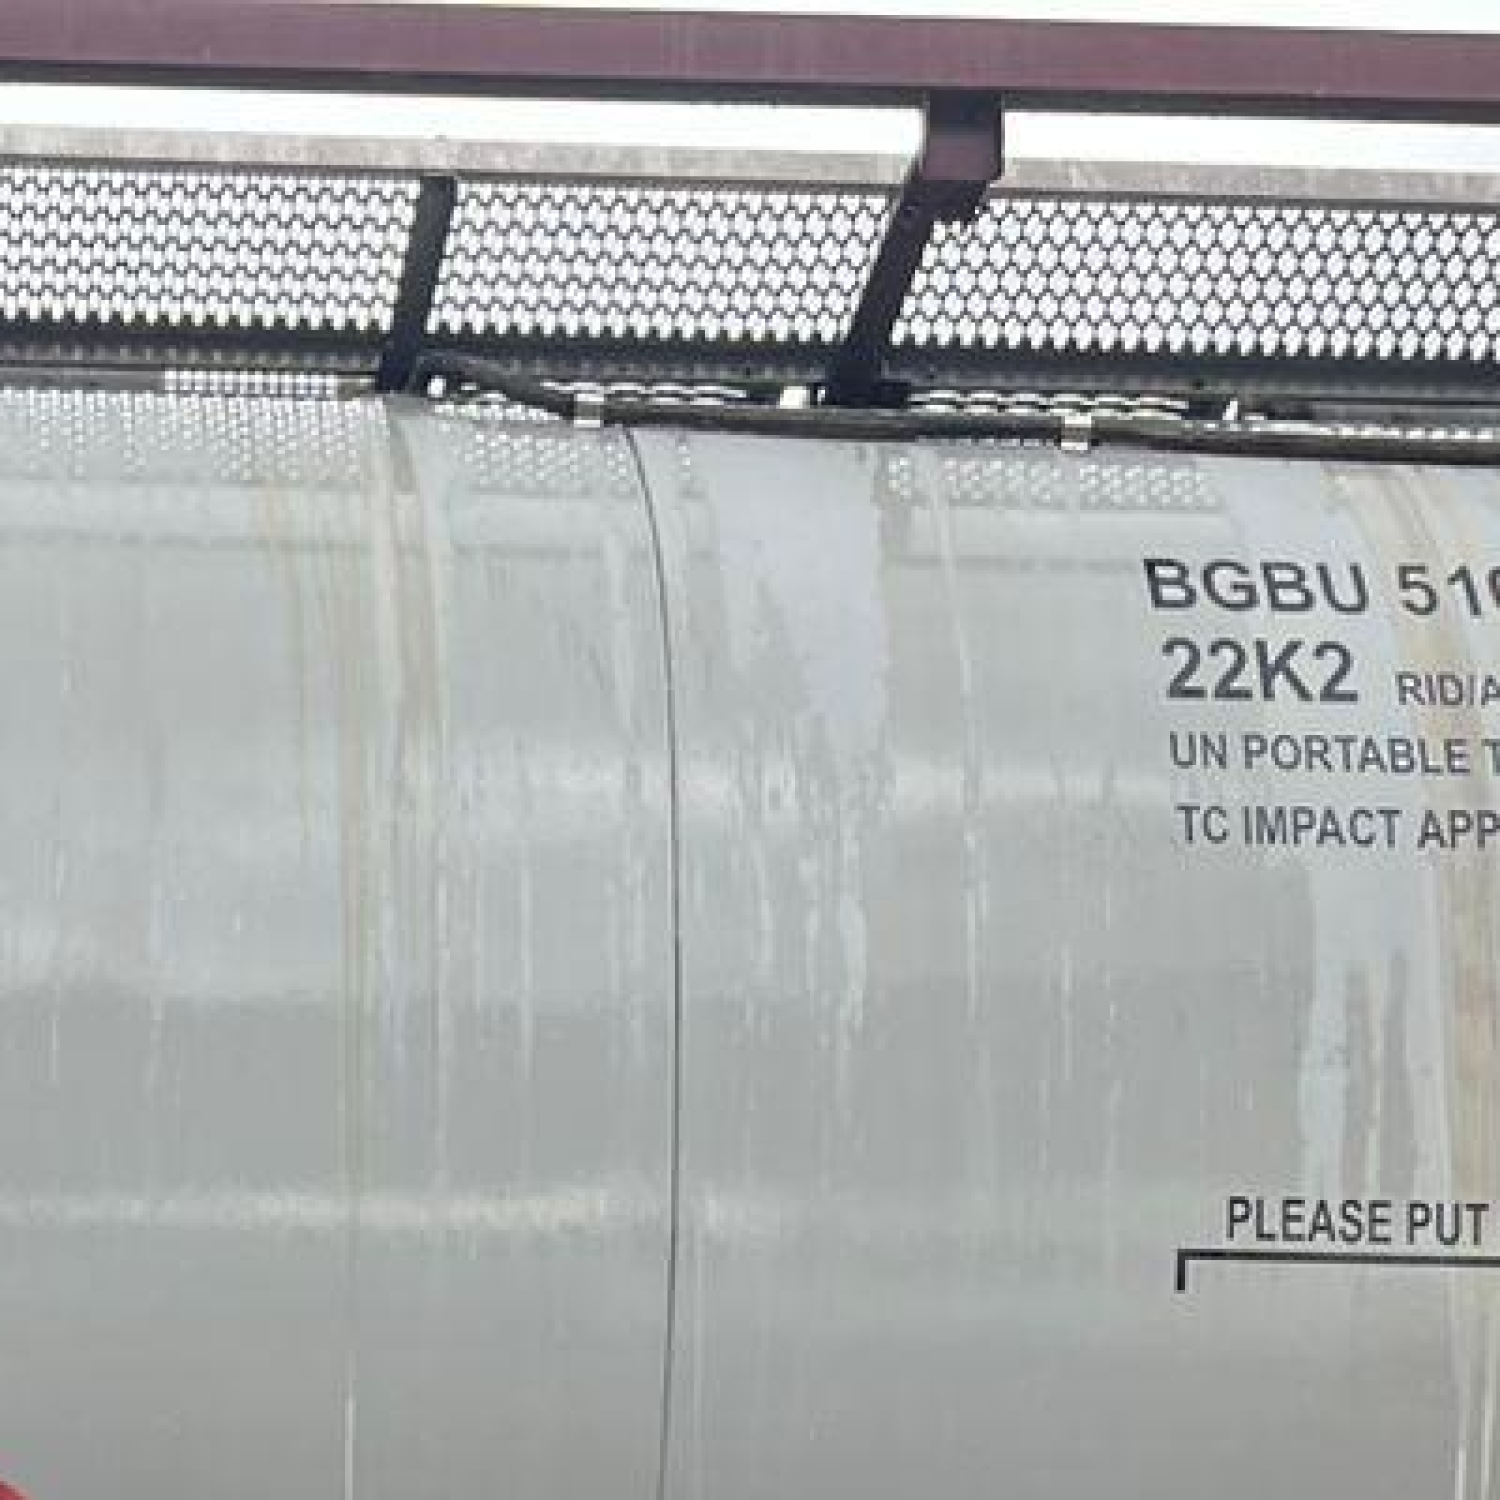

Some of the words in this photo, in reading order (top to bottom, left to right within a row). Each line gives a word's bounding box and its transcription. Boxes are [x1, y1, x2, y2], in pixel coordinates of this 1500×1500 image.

[1144, 558, 1369, 612] BGBU
[1161, 636, 1359, 702] 22K2
[1169, 731, 1229, 769] UN
[1243, 735, 1470, 775] PORTABLE
[1176, 804, 1229, 844] TC
[1243, 806, 1402, 847] IMPACT
[1225, 1195, 1393, 1245] PLEASE
[1407, 1202, 1490, 1246] PUT
